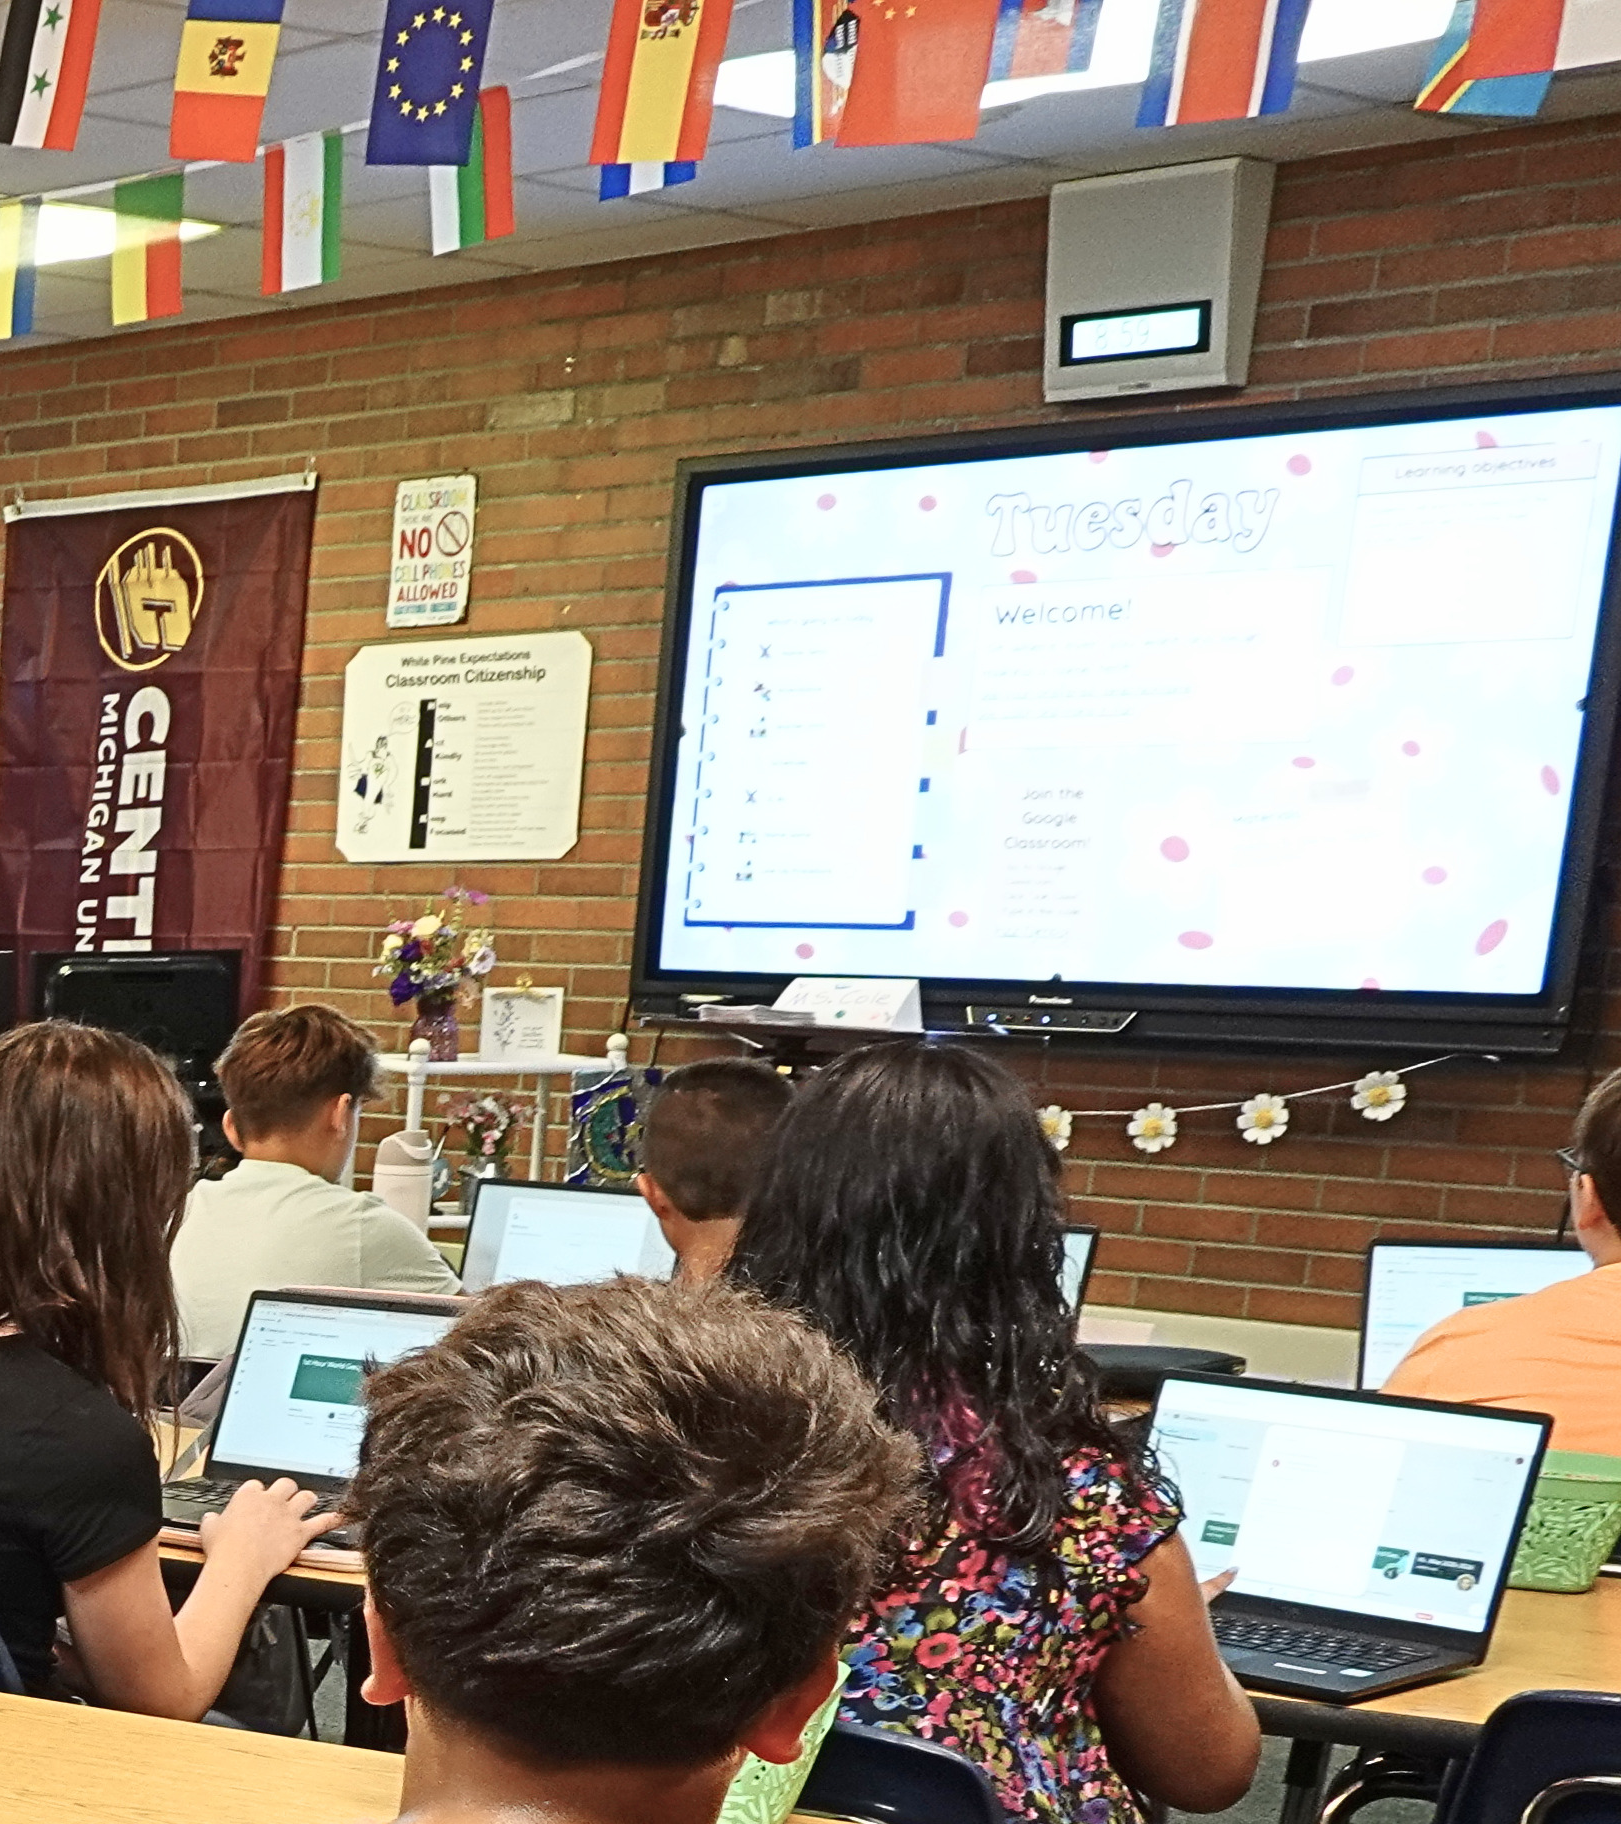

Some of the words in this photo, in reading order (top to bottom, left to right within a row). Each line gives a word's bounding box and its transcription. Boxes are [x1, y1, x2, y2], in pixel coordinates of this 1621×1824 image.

[1394, 461, 1466, 479] Learning
[1472, 455, 1557, 476] objectives
[985, 478, 1281, 557] Tuesday
[400, 526, 432, 560] NO
[395, 581, 459, 604] ALLOWED
[995, 599, 1133, 625] Welcome!
[401, 655, 431, 667] White
[433, 653, 456, 666] Pine
[458, 649, 532, 665] Expectations
[386, 671, 461, 689] Classroom
[464, 664, 547, 688] Citizenship
[79, 692, 121, 884] MICHIGAN
[1021, 787, 1054, 801] Join
[1058, 787, 1085, 800] the
[102, 685, 171, 952] CENT
[1021, 811, 1078, 827] Google
[1003, 835, 1092, 852] Classroom!
